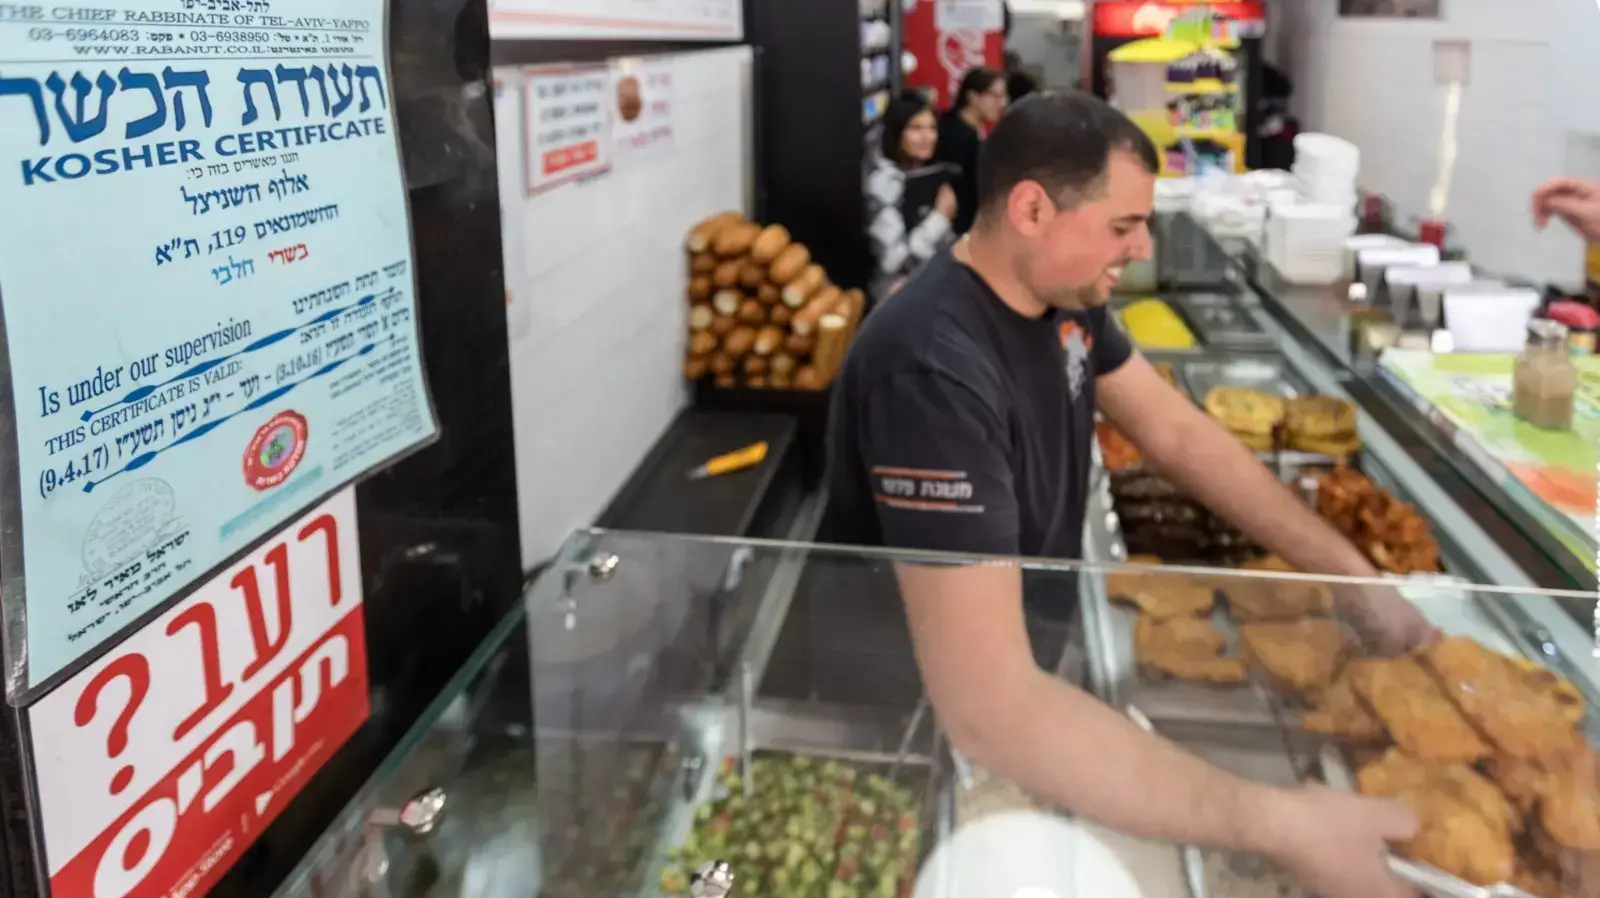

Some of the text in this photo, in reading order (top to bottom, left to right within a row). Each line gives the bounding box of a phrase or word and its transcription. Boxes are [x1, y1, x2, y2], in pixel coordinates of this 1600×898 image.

[28, 27, 140, 42] 03-6964083
[52, 7, 117, 22] CHIEF
[124, 10, 229, 24] RABBINATE
[234, 14, 254, 26] OF
[190, 31, 270, 43] 03-6938950
[73, 45, 266, 55] WWW.RABANUT.CO.IL
[0, 62, 387, 147] תעודת הכשר
[21, 116, 387, 187] KOSHER CERTIFICATE
[186, 152, 300, 180] הננו מאשרים בזה כי:
[180, 168, 310, 216] אלוף השניצל
[207, 225, 247, 255] 119,
[253, 204, 340, 240] החשמונאים
[211, 243, 310, 286] בשרי חלבי
[39, 317, 252, 418] Is under our supervision
[45, 359, 244, 456] THIS CERTIFICATE IS VALID:
[39, 443, 110, 500] (9.4.17)
[67, 530, 190, 614] ישראל מאיר לאו
